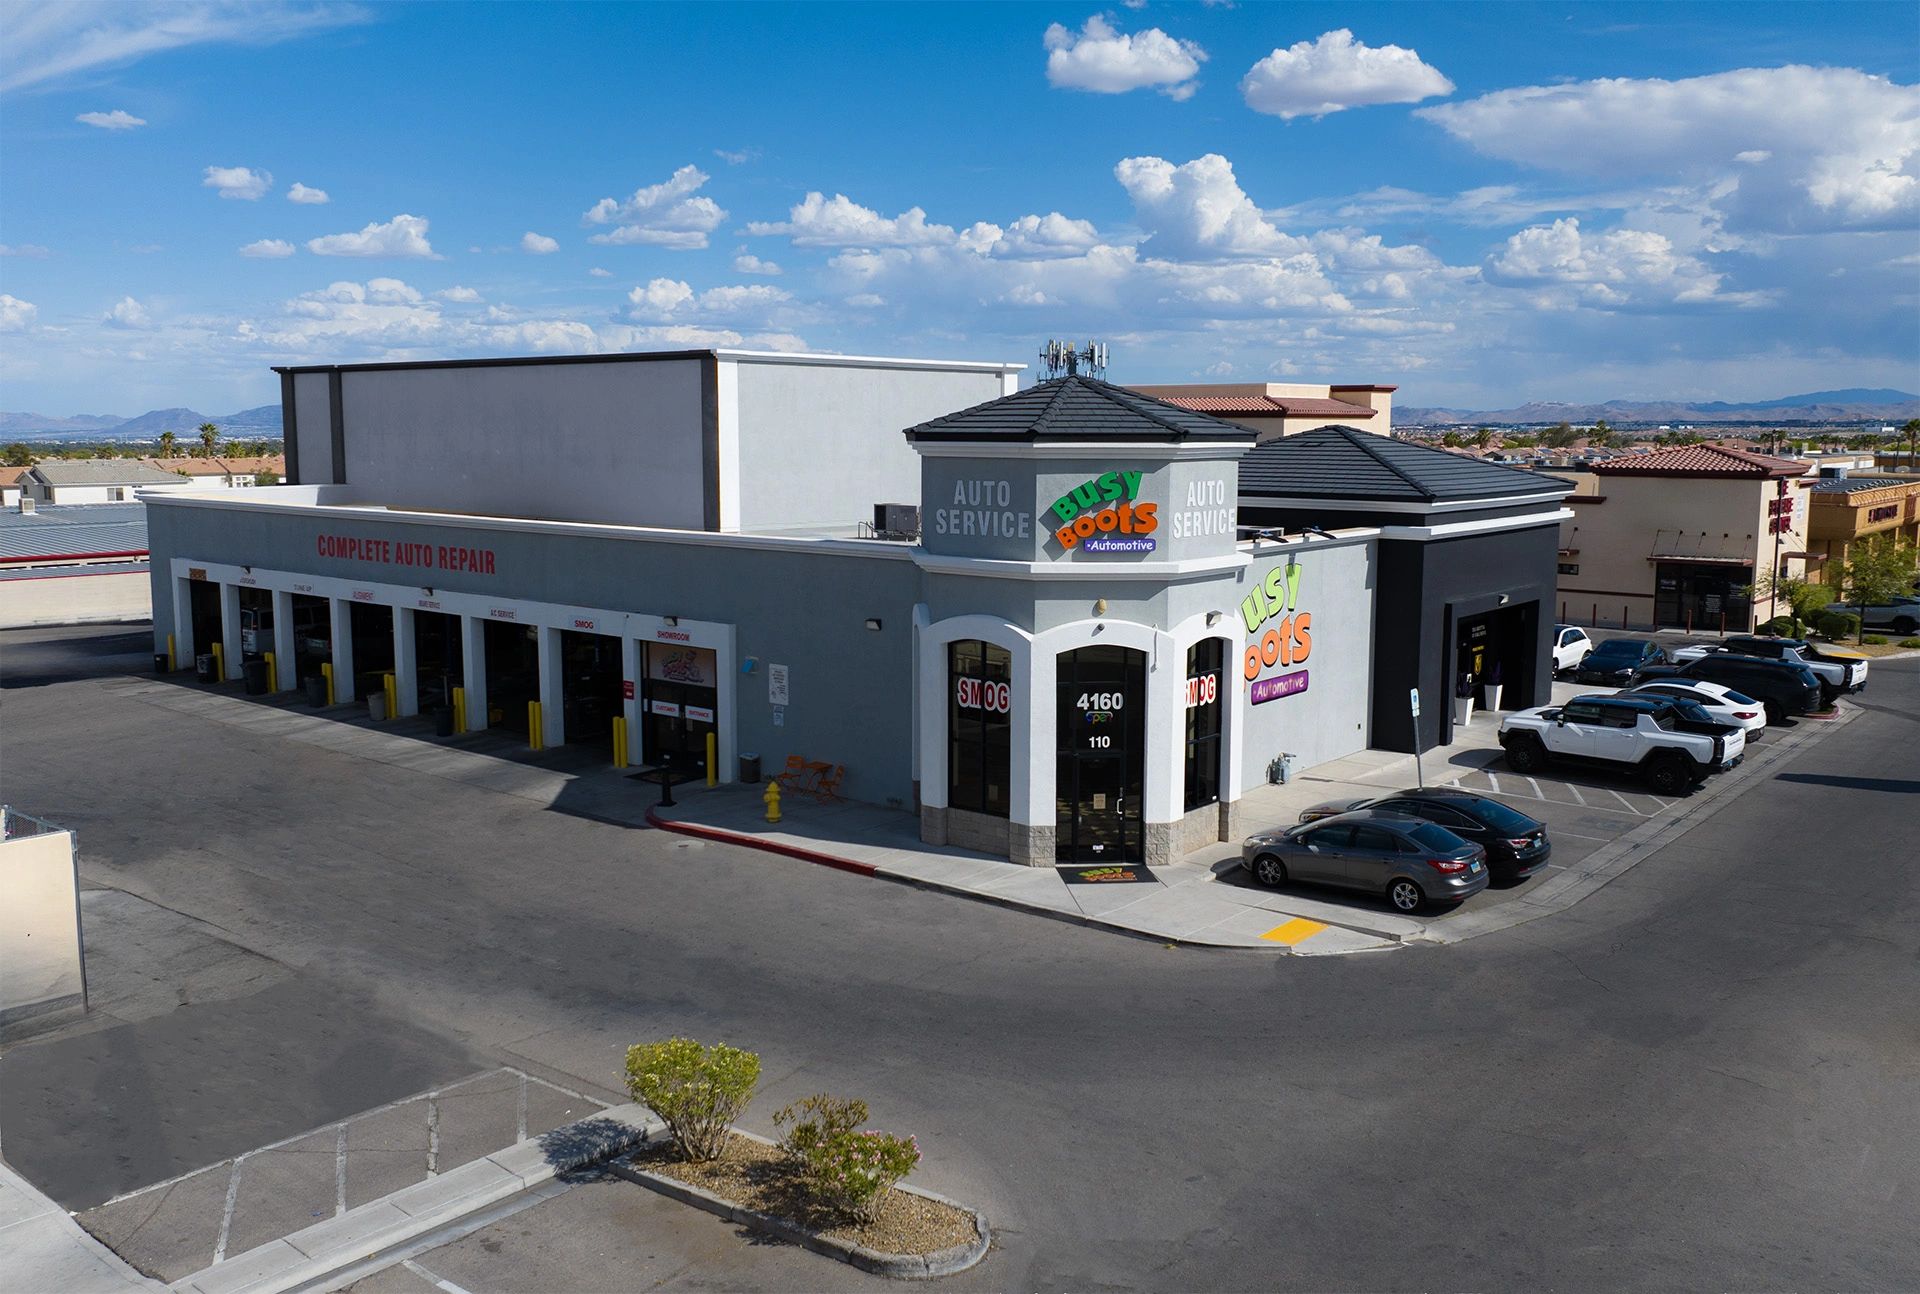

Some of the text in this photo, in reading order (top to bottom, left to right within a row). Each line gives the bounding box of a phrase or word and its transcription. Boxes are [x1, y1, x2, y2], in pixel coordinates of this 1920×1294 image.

[953, 480, 1010, 507] AUTO
[1186, 480, 1224, 506] AUTO
[936, 509, 1029, 538] SERVICE
[1173, 508, 1235, 538] SERVICE
[318, 535, 495, 574] COMPLETE AUTO REPAIR
[1090, 540, 1153, 551] Automotive
[1241, 563, 1302, 633] USY
[497, 610, 515, 619] SERVICE
[574, 619, 594, 629] SMOG
[656, 630, 690, 641] SHOWROOM
[1245, 612, 1311, 681] oots
[957, 678, 1010, 712] SMOG
[1256, 676, 1305, 699] Automotive
[1076, 692, 1124, 710] 4160
[1088, 736, 1111, 748] 110
